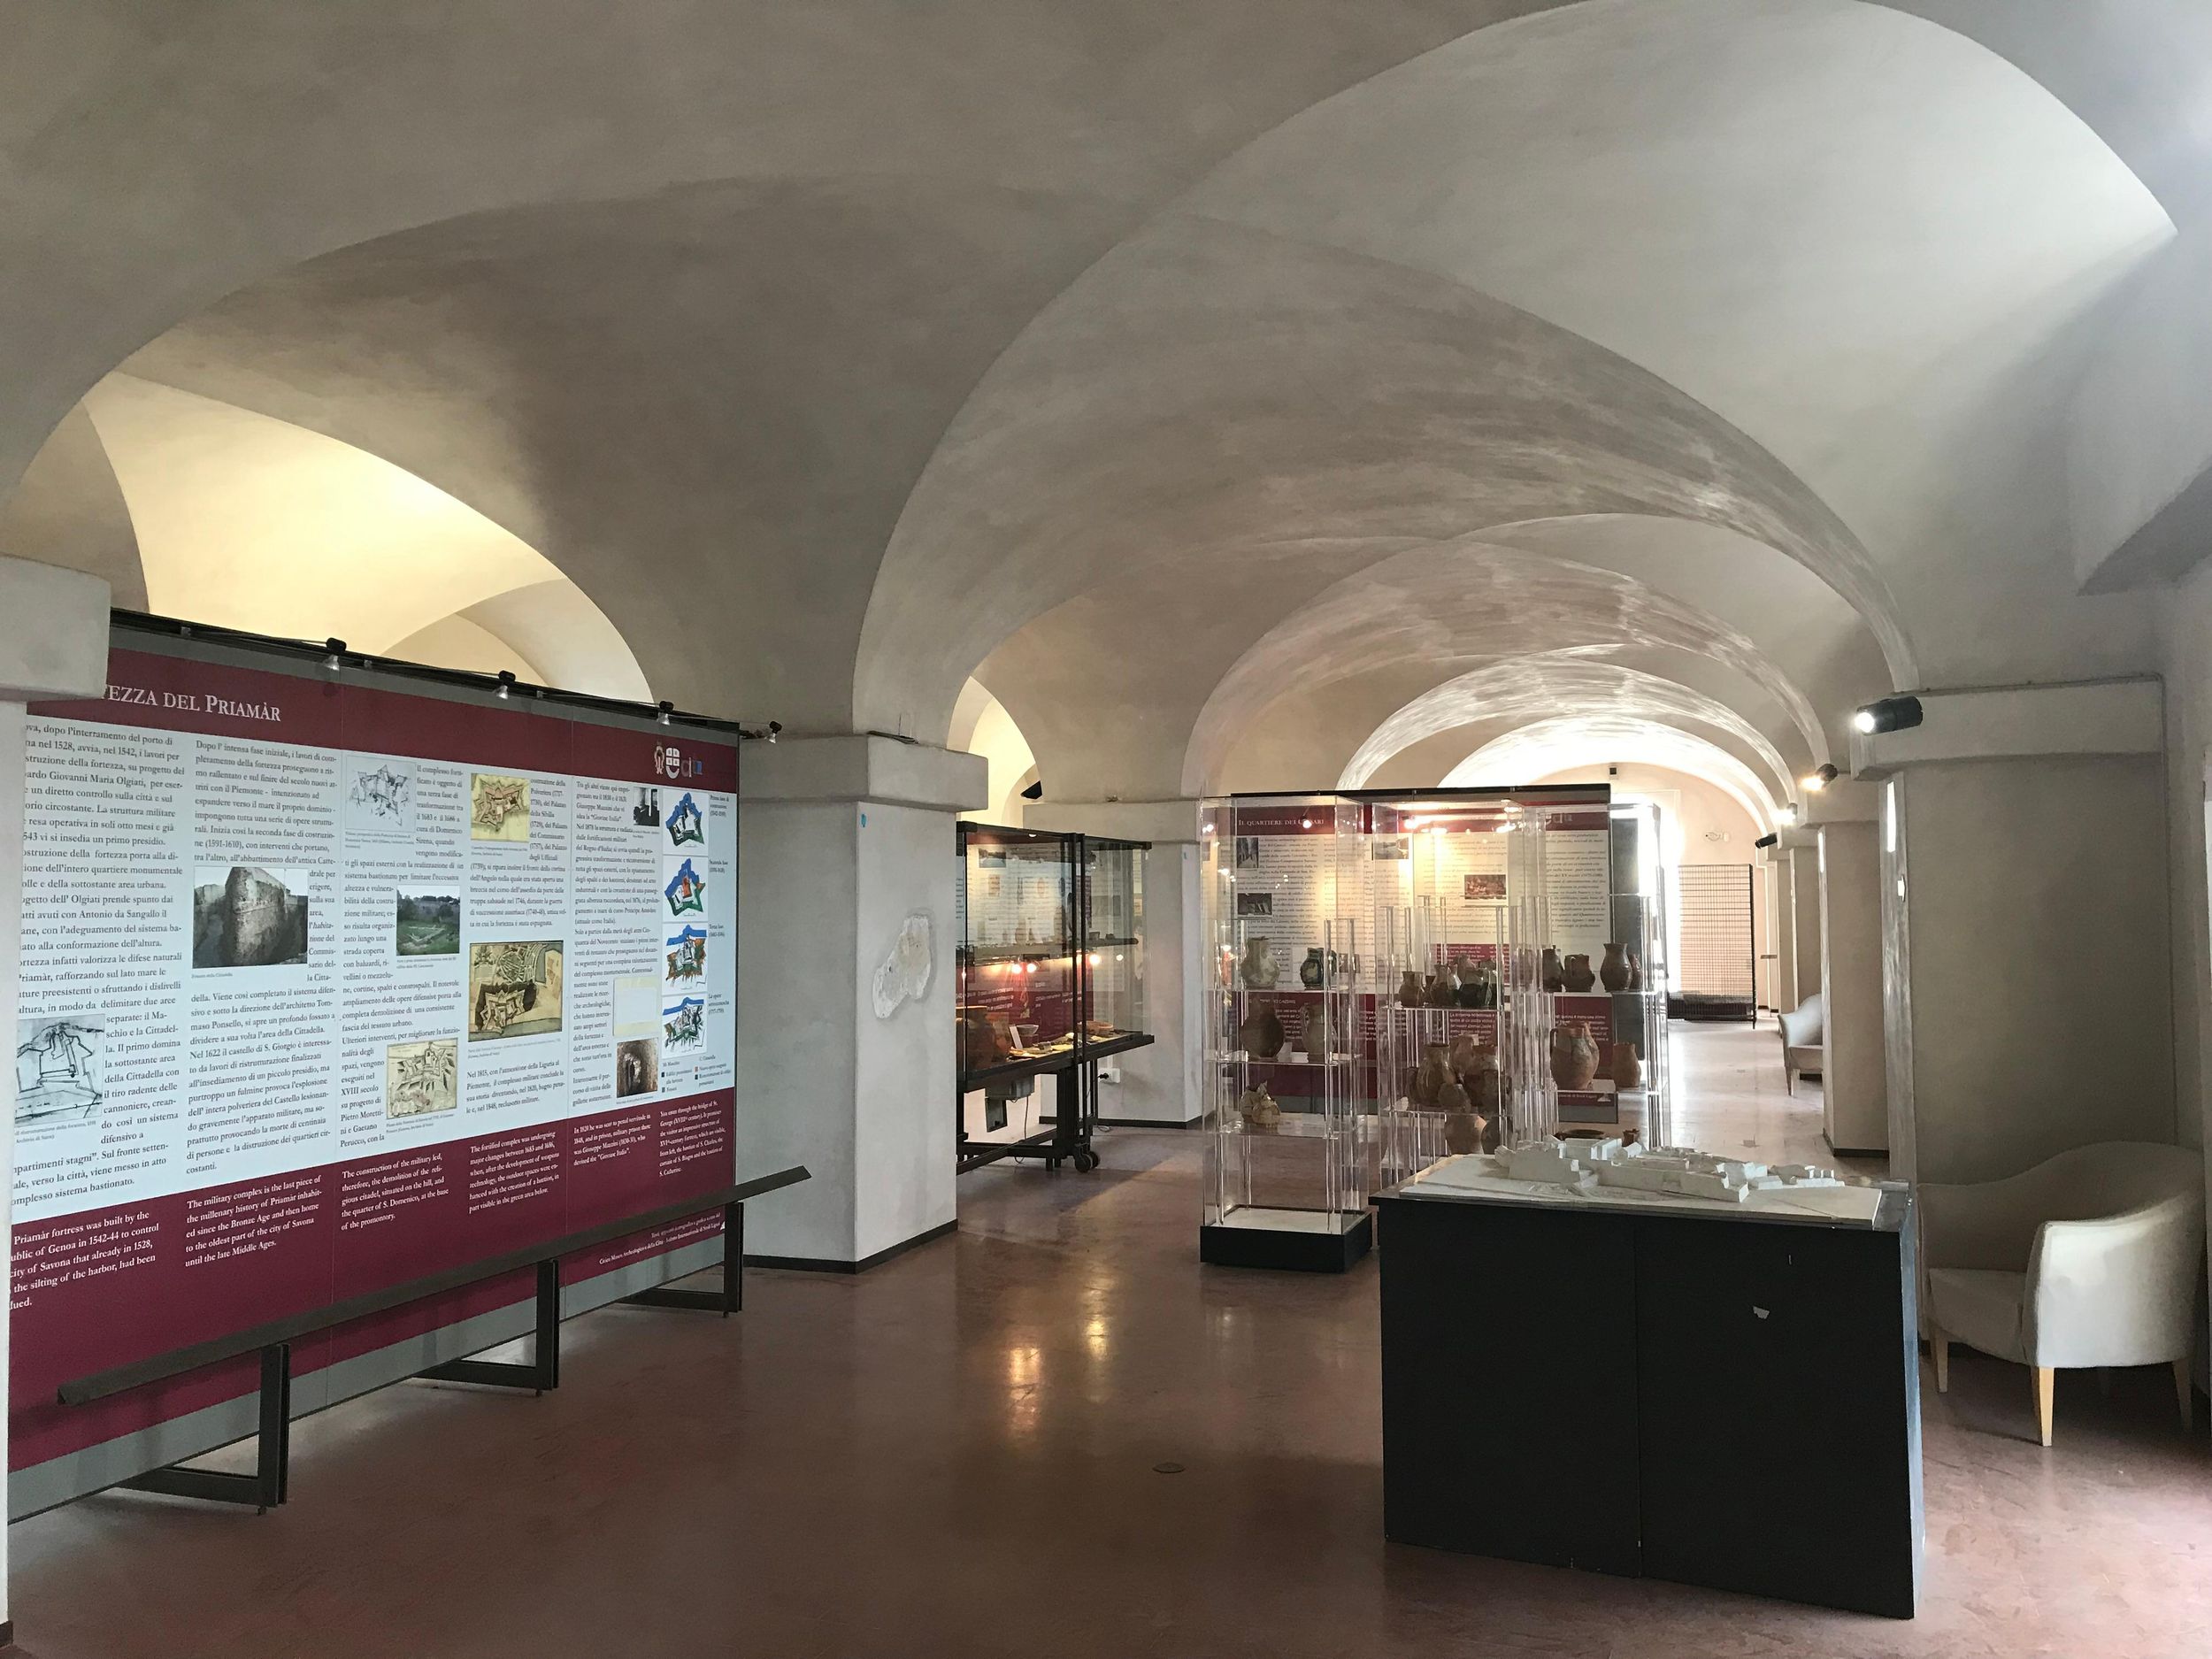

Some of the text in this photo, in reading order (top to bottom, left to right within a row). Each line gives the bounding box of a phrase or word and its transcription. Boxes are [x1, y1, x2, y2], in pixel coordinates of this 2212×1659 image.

[103, 684, 280, 721] EZZA DEL PRIAMÀR
[38, 740, 52, 749] nel
[54, 741, 75, 752] 1528,
[77, 745, 101, 755] avvia,
[118, 746, 137, 757] 1542,
[143, 749, 165, 759] lavori
[166, 753, 179, 762] per
[43, 724, 65, 736] dopo
[127, 733, 140, 742] del
[142, 736, 164, 745] porto
[49, 771, 88, 782] Giovanni
[89, 773, 114, 784] Maria
[116, 776, 146, 787] Olgiati,
[150, 780, 163, 789] per
[186, 1200, 203, 1209] The
[233, 1187, 263, 1200] complex
[271, 1183, 282, 1192] the
[296, 1178, 312, 1189] piece
[313, 1174, 321, 1183] of
[187, 1188, 321, 1224] the millenary history of Priamàr inhabit-
[14, 1231, 50, 1245] Priamàr
[51, 1225, 83, 1238] fortress
[104, 1216, 123, 1226] built
[125, 1214, 134, 1225] by
[136, 1210, 150, 1220] the
[186, 1228, 196, 1238] ed
[196, 1226, 216, 1235] since
[218, 1222, 229, 1231] the
[230, 1217, 255, 1228] Bronze
[257, 1214, 270, 1224] Age
[272, 1209, 284, 1219] and
[301, 1203, 319, 1212] home
[195, 1241, 207, 1250] the
[208, 1236, 230, 1247] oldest
[231, 1233, 246, 1245] part
[247, 1228, 255, 1238] of
[257, 1227, 268, 1236] the
[269, 1225, 281, 1233] city
[282, 1220, 290, 1230] of
[292, 1217, 314, 1228] Savona
[27, 1263, 36, 1273] of
[40, 1259, 70, 1271] Savona
[73, 1254, 89, 1263] that
[91, 1246, 120, 1260] already
[123, 1244, 131, 1253] in
[134, 1239, 152, 1250] 1528,
[35, 1246, 44, 1256] of
[48, 1242, 76, 1254] Genoa
[78, 1238, 87, 1248] in
[89, 1231, 119, 1245] 1542-44
[131, 1223, 158, 1236] control
[185, 1255, 203, 1267] until
[204, 1253, 216, 1263] the
[232, 1243, 257, 1256] Middle
[258, 1240, 276, 1250] Ages.
[13, 1255, 155, 1293] the silting of the harbor, had been
